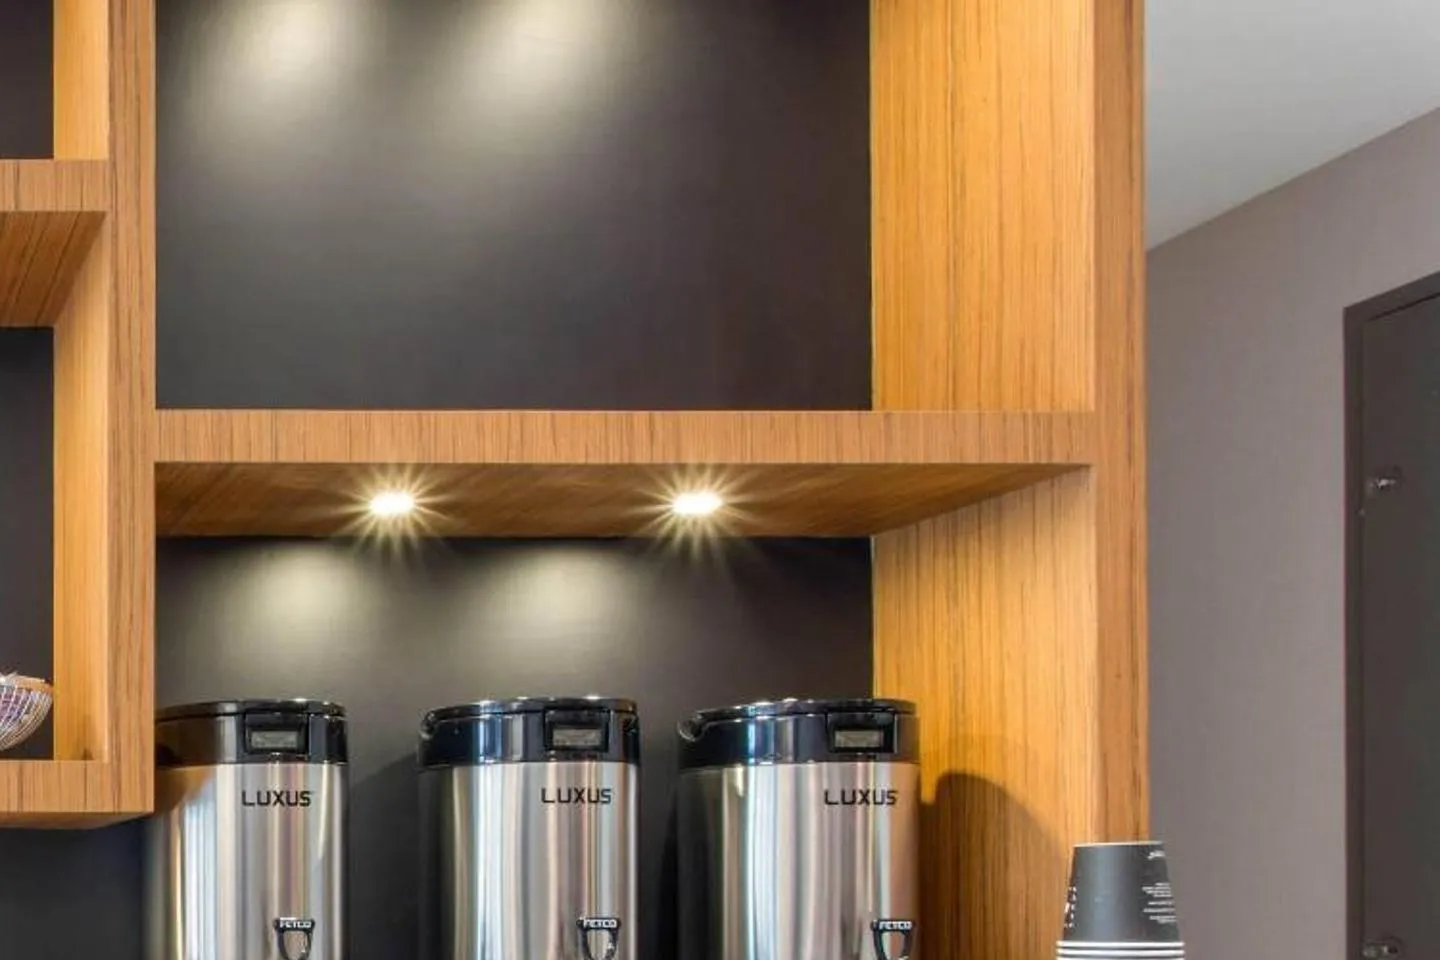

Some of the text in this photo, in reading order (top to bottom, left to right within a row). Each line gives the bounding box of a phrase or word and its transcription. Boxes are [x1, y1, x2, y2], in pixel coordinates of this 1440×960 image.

[242, 790, 311, 807] LUXUS
[541, 787, 612, 804] LUXUS
[824, 789, 898, 806] LUXUS
